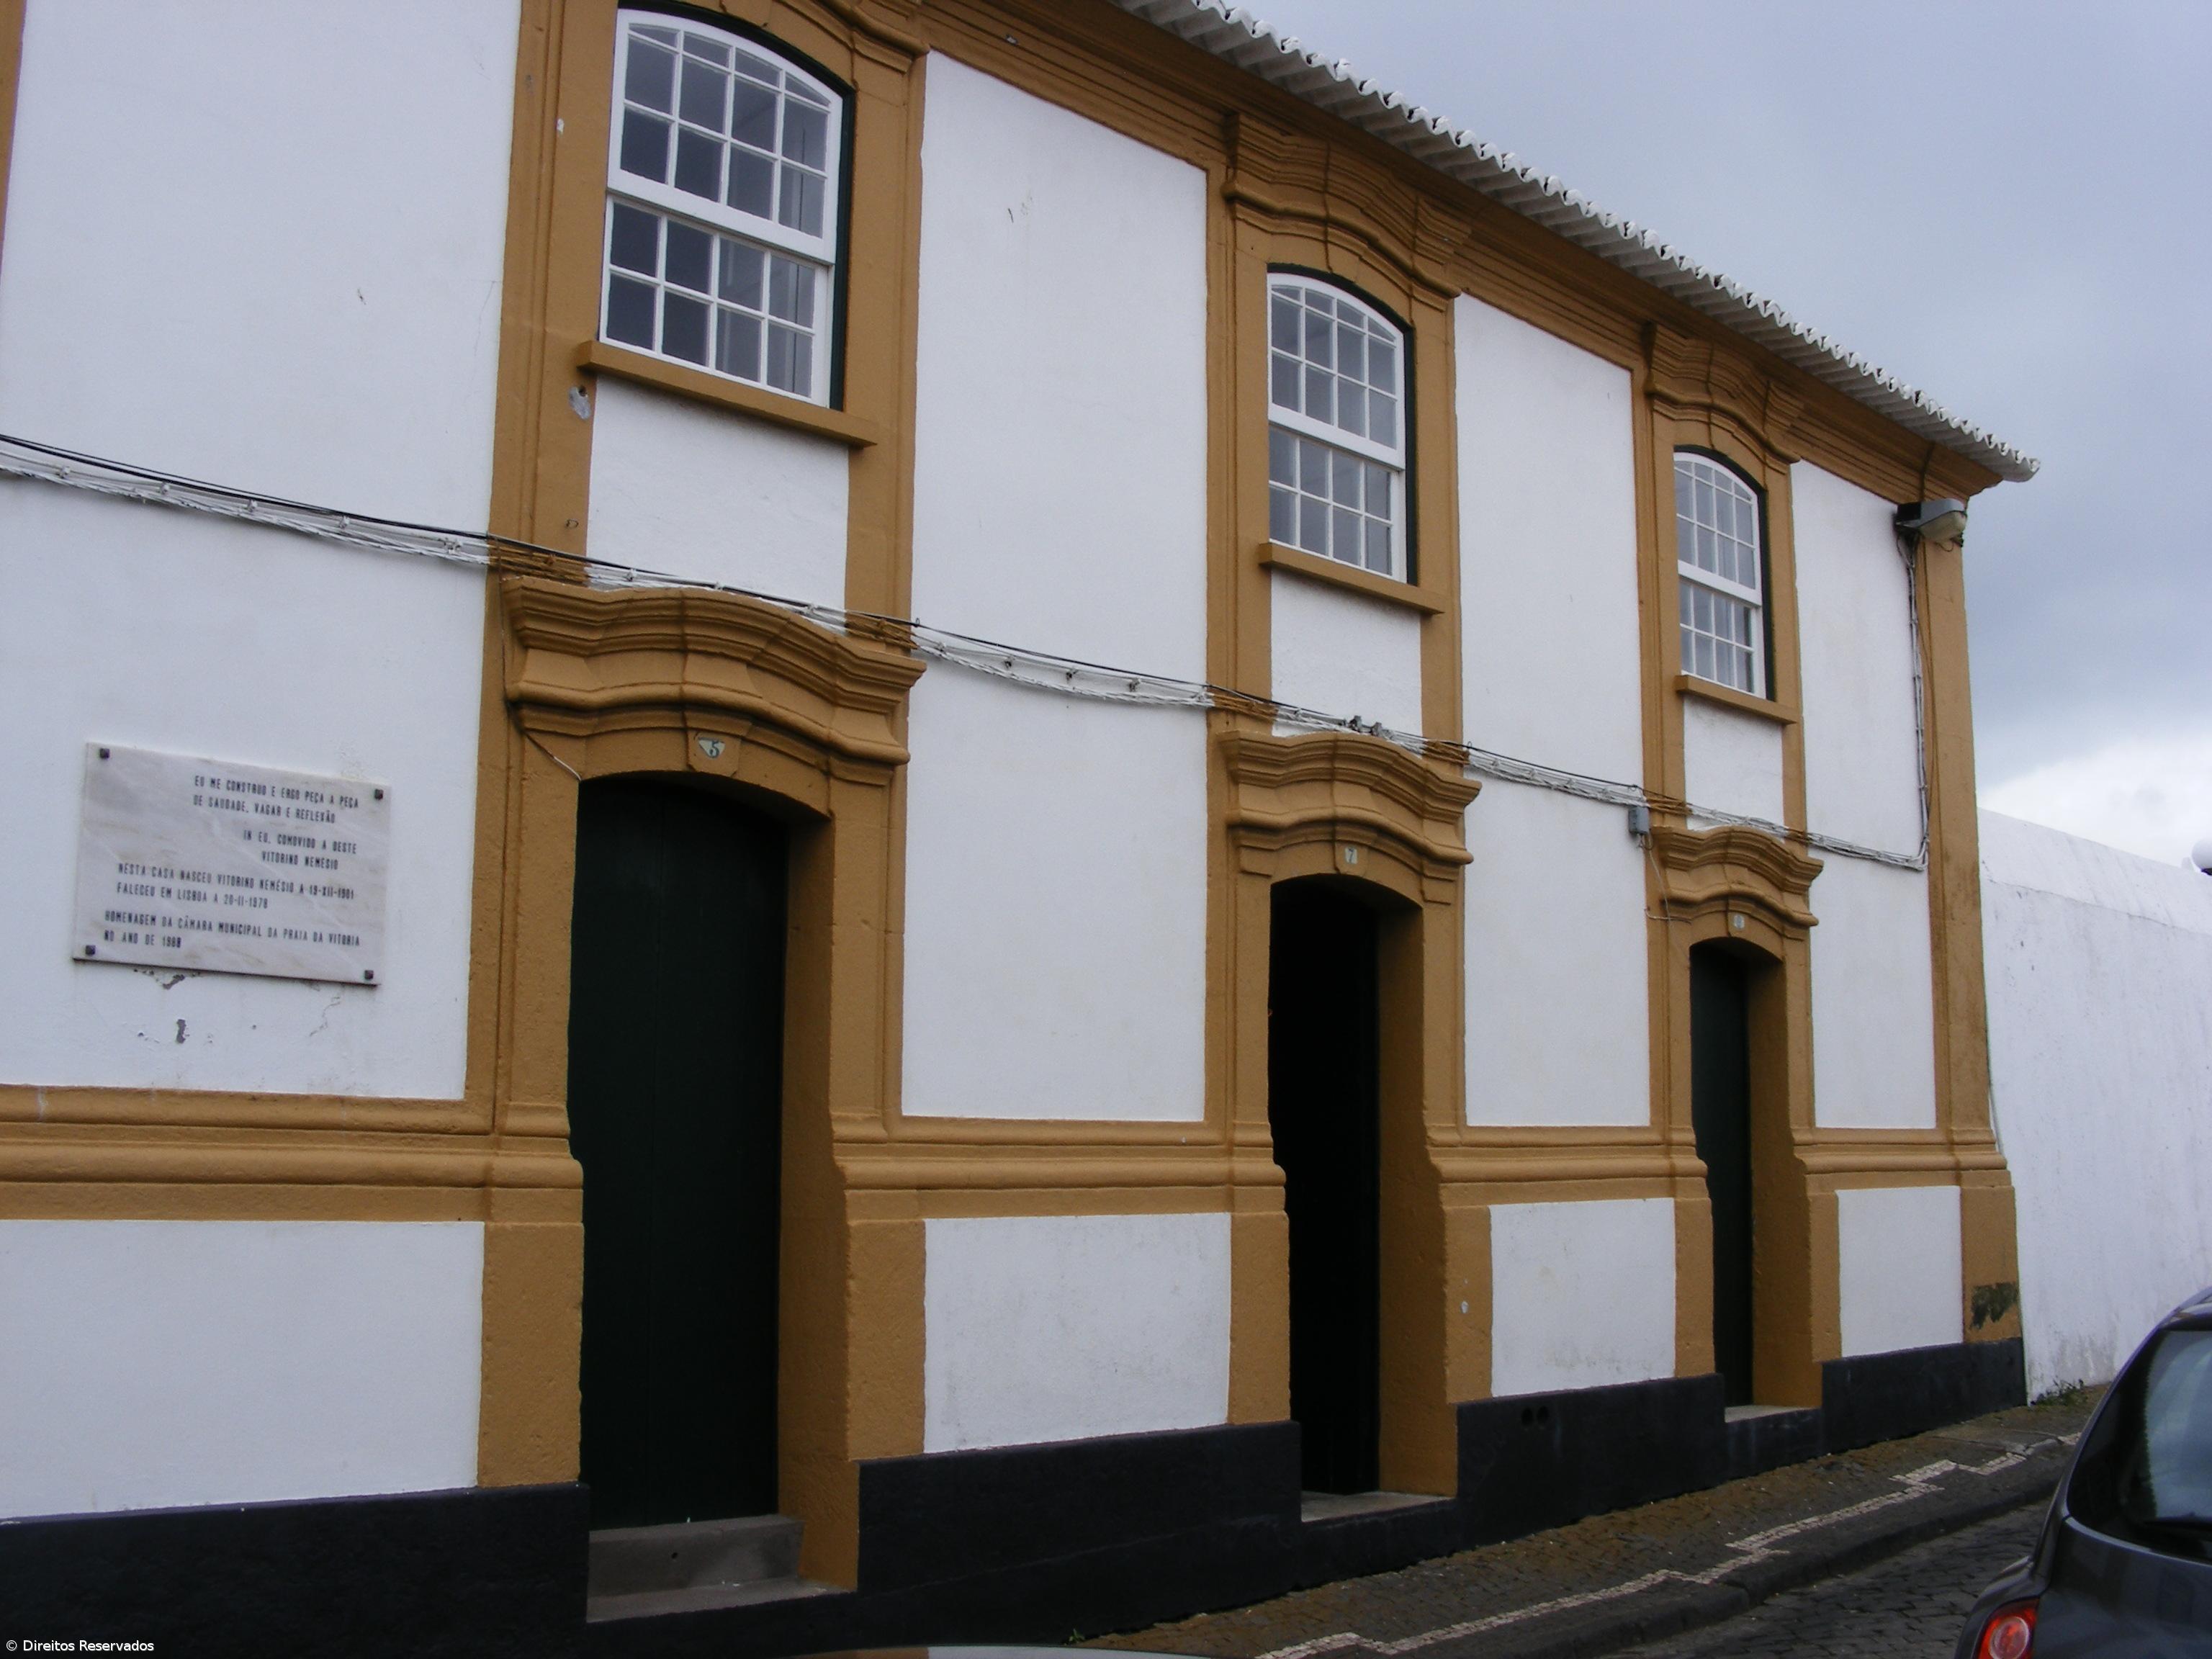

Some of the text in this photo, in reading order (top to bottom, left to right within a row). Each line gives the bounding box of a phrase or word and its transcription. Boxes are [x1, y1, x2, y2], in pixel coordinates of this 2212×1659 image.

[709, 740, 719, 758] 5
[194, 775, 359, 809] EU ME CONSTRUO E ERGO PEÇA A PEÇA
[193, 794, 202, 806] DE
[254, 802, 281, 817] VAGAR
[286, 806, 290, 818] E
[296, 808, 336, 824] REFLEXÃO
[243, 830, 251, 840] IN
[277, 833, 316, 848] COMOVIDO
[322, 840, 326, 850] A
[261, 850, 298, 865] VITORINO
[119, 863, 145, 876] NESTA
[151, 866, 174, 878] CASA
[180, 869, 212, 884] NASCEU
[217, 873, 254, 889] VITORINO
[259, 878, 294, 893] NEMÉSIO
[299, 883, 304, 894] A
[117, 881, 155, 896] FALECEU
[161, 886, 172, 899] EM
[177, 889, 207, 902] LISBOA
[214, 892, 218, 903] A
[104, 910, 156, 926] HOMENAGEM
[162, 916, 172, 927] DA
[178, 915, 213, 932] CÂMARA
[218, 922, 261, 937] MUNICIPAL
[267, 927, 277, 938] DA
[283, 928, 307, 940] PRAIA
[313, 932, 323, 943] DA
[104, 929, 114, 942] NO
[122, 932, 138, 944] ANO
[145, 934, 155, 945] DE
